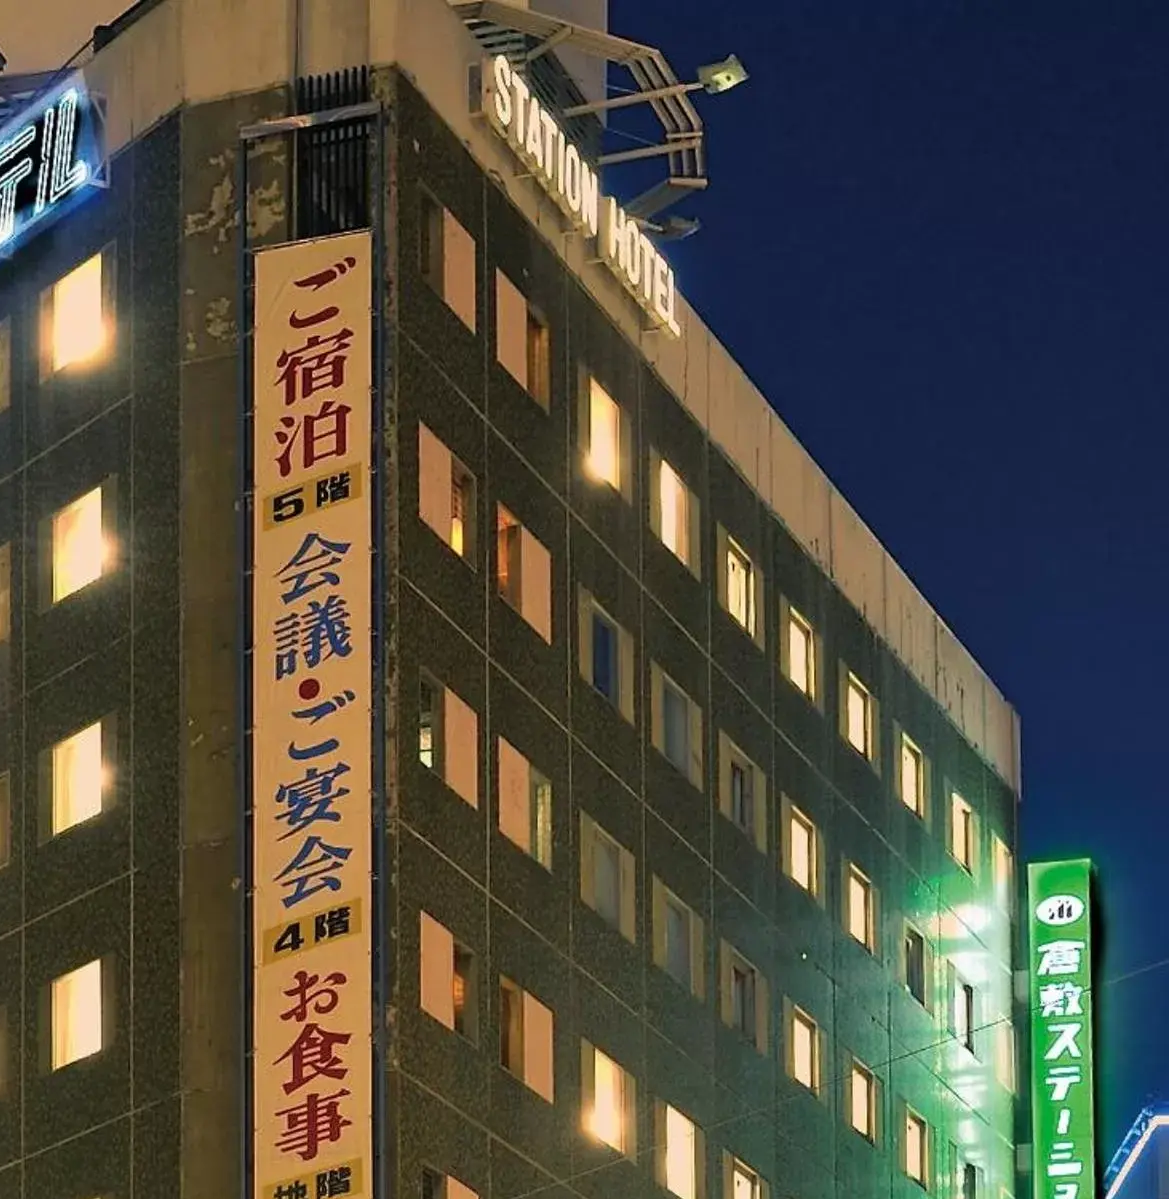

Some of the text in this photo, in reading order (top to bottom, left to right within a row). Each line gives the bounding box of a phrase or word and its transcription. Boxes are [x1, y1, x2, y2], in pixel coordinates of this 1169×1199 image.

[494, 55, 680, 337] STATION HOTEL
[274, 257, 356, 477] ご宿泊
[273, 471, 351, 522] 5階
[273, 907, 351, 953] 4階
[272, 970, 352, 1160] お食事
